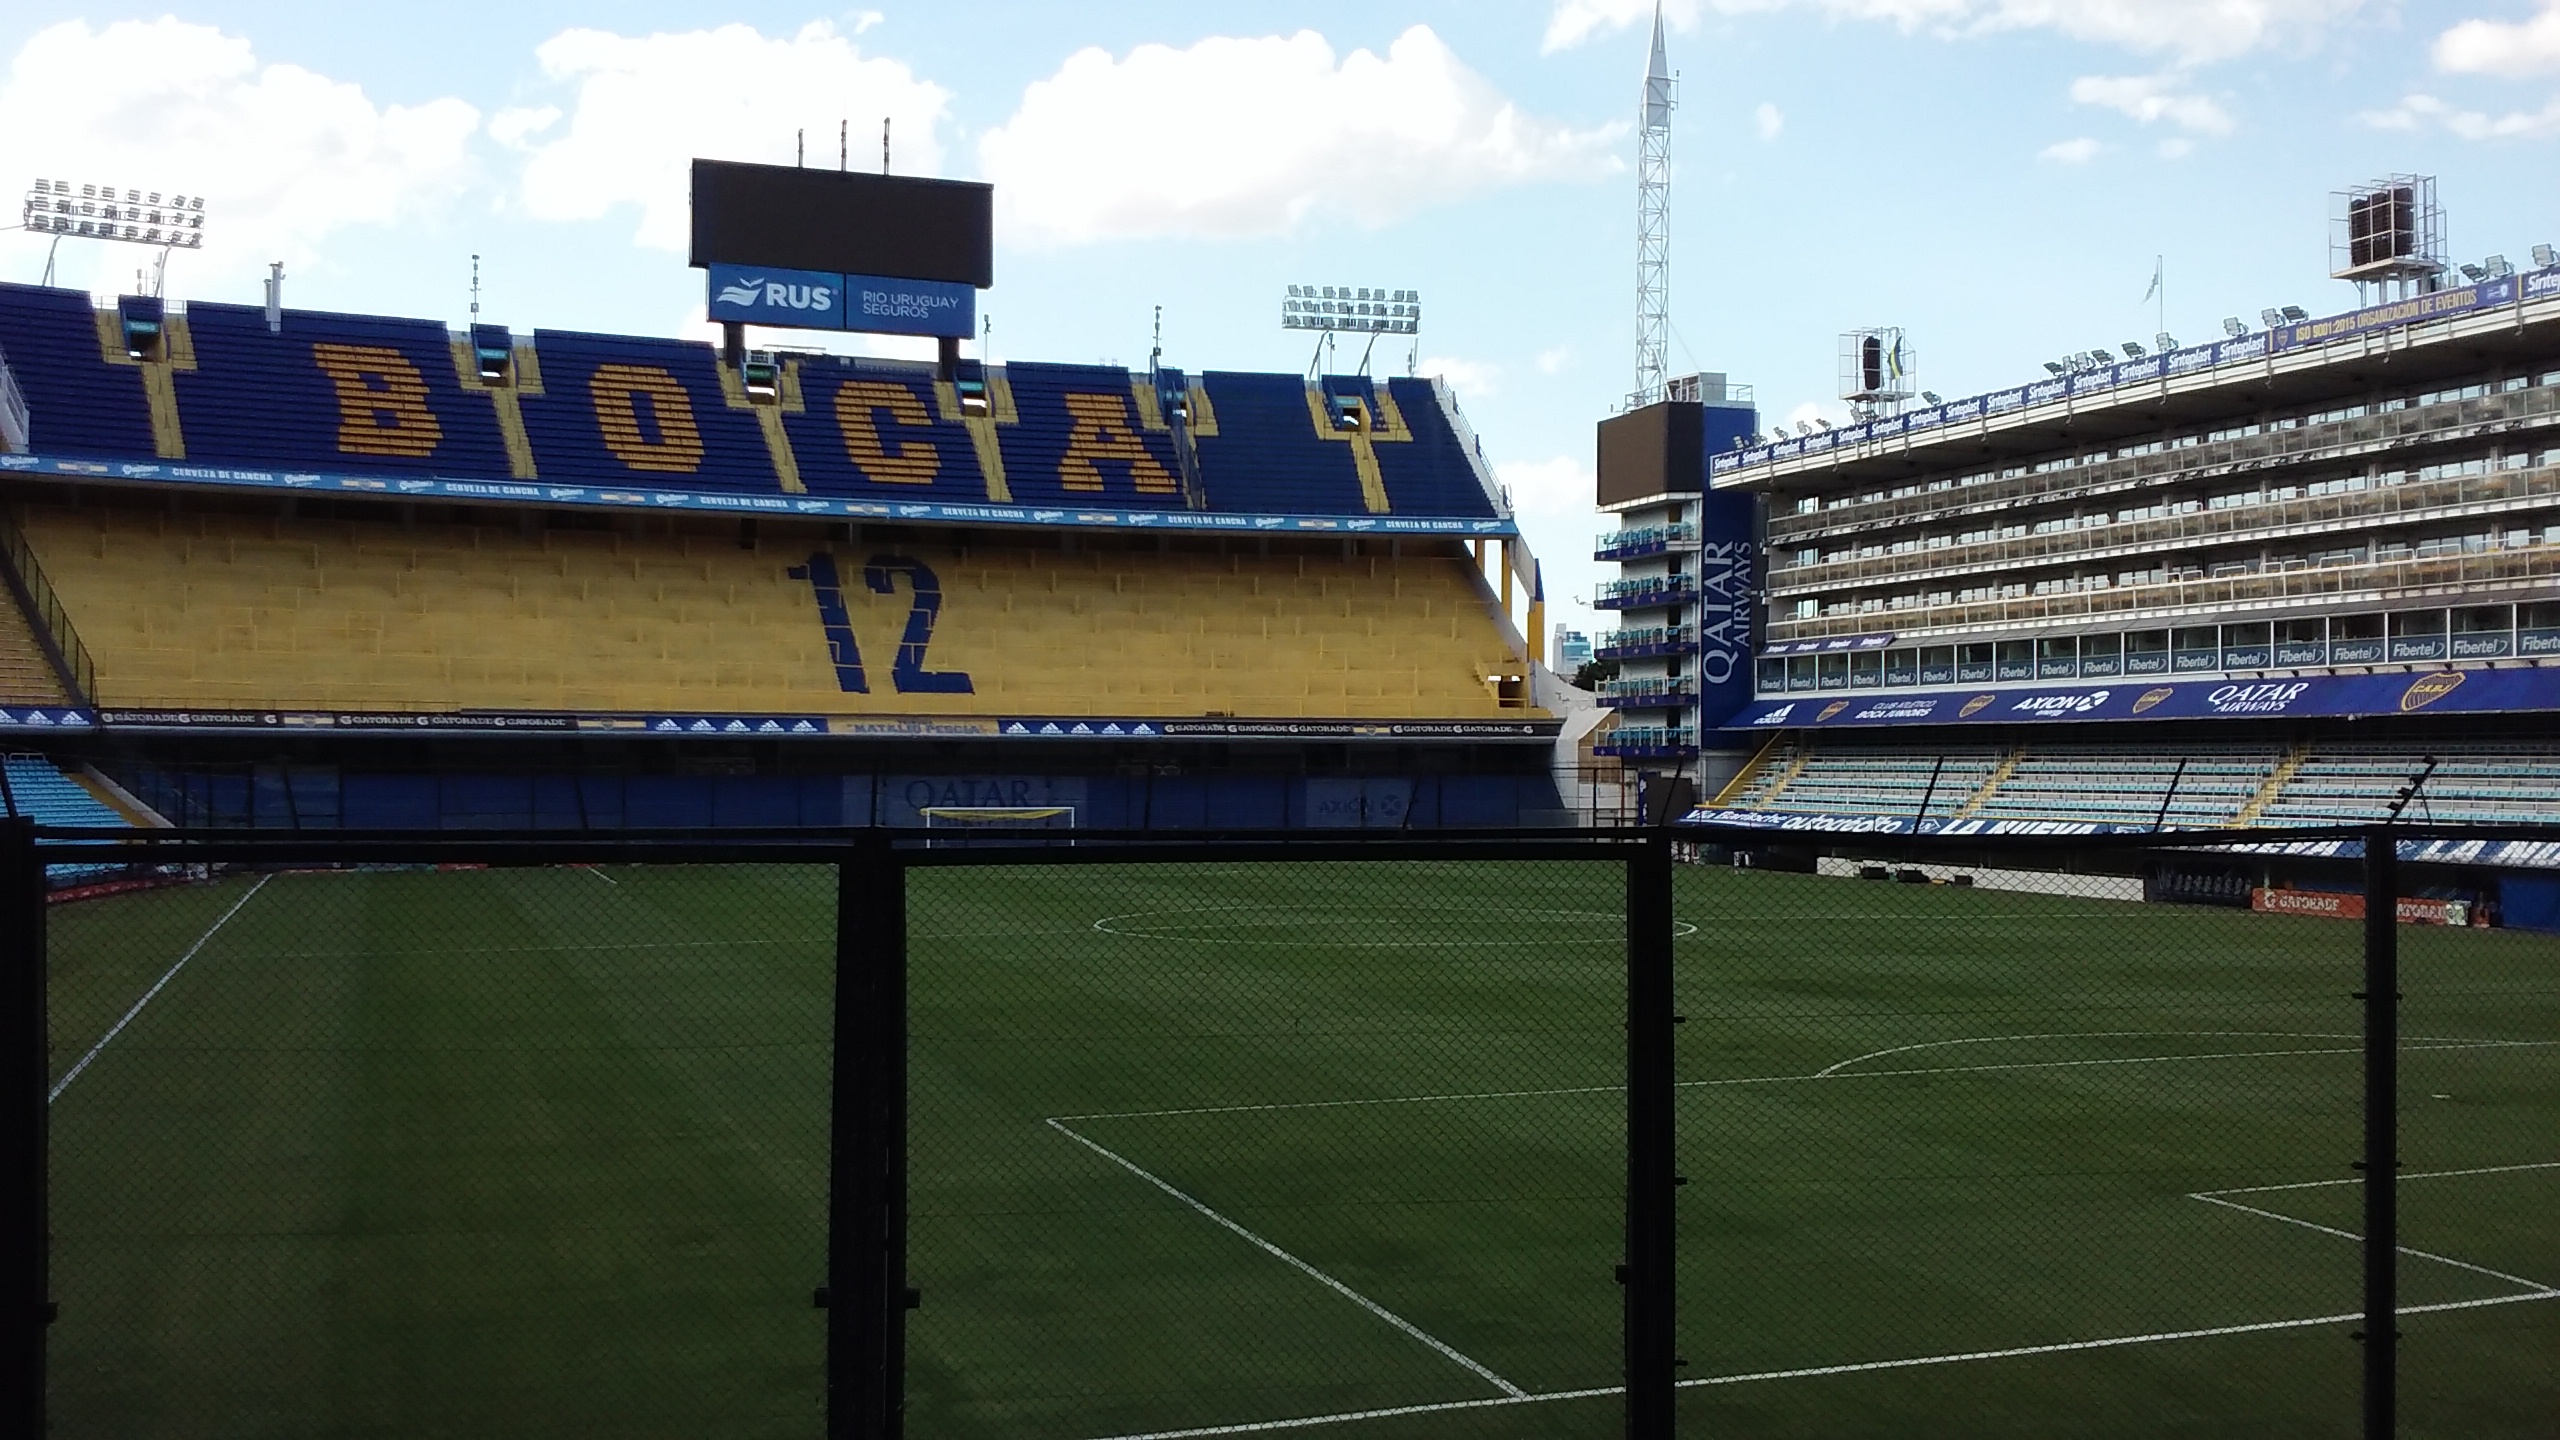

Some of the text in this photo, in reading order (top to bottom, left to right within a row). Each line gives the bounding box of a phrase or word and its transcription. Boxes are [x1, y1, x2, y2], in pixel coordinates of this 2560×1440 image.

[2528, 273, 2560, 293] Sinte
[766, 283, 832, 311] RUS
[862, 290, 959, 309] RIO URUGUAY
[862, 303, 929, 319] SEGUROS
[2295, 325, 2311, 342] ISO
[2421, 298, 2434, 314] DE
[2435, 289, 2477, 311] EVENTOS
[2219, 335, 2266, 360] Sinteplast
[2168, 348, 2212, 370] Sinteplast
[2119, 359, 2160, 381] Sinteplast
[2073, 369, 2113, 391] Sinteplast
[2028, 380, 2066, 401] Sinteplast
[1987, 390, 2023, 411] Sinteplast
[1946, 400, 1980, 420] Sinteplast
[1908, 409, 1941, 428] Sinteplast
[1871, 418, 1904, 437] Sinteplast
[171, 468, 216, 479] CERVEZA
[218, 470, 231, 479] DE
[445, 483, 487, 493] CERVEZA
[489, 485, 501, 494] DE
[942, 507, 979, 516] CERVEZA
[980, 509, 991, 517] DE
[1385, 520, 1418, 529] CERVEZA
[1421, 521, 1431, 529] DE
[1733, 541, 1751, 647] AIRWAYS
[1703, 540, 1739, 684] QATAR
[788, 551, 976, 696] 12
[2393, 641, 2436, 658] Fibertel
[2454, 638, 2499, 655] Fibertel
[2522, 635, 2560, 651] Fibert
[2176, 655, 2210, 668] Fibertel
[2227, 652, 2262, 666] Fibertel
[2278, 648, 2317, 663] Fibertel
[2334, 646, 2374, 661] Fibertel
[2000, 666, 2028, 679] Fibertel
[2041, 663, 2071, 676] Fibertel
[2084, 660, 2114, 673] Fibertel
[2129, 658, 2161, 671] Fibertel
[1888, 673, 1912, 684] Fibertel
[1923, 671, 1949, 682] Fibertel
[1960, 669, 1988, 681] Fibertel
[2207, 682, 2310, 705] QATAR
[2011, 695, 2084, 711] AXION
[2212, 700, 2291, 712] AIRWAYS
[905, 780, 1031, 811] QATAR
[1936, 819, 1986, 835] LA
